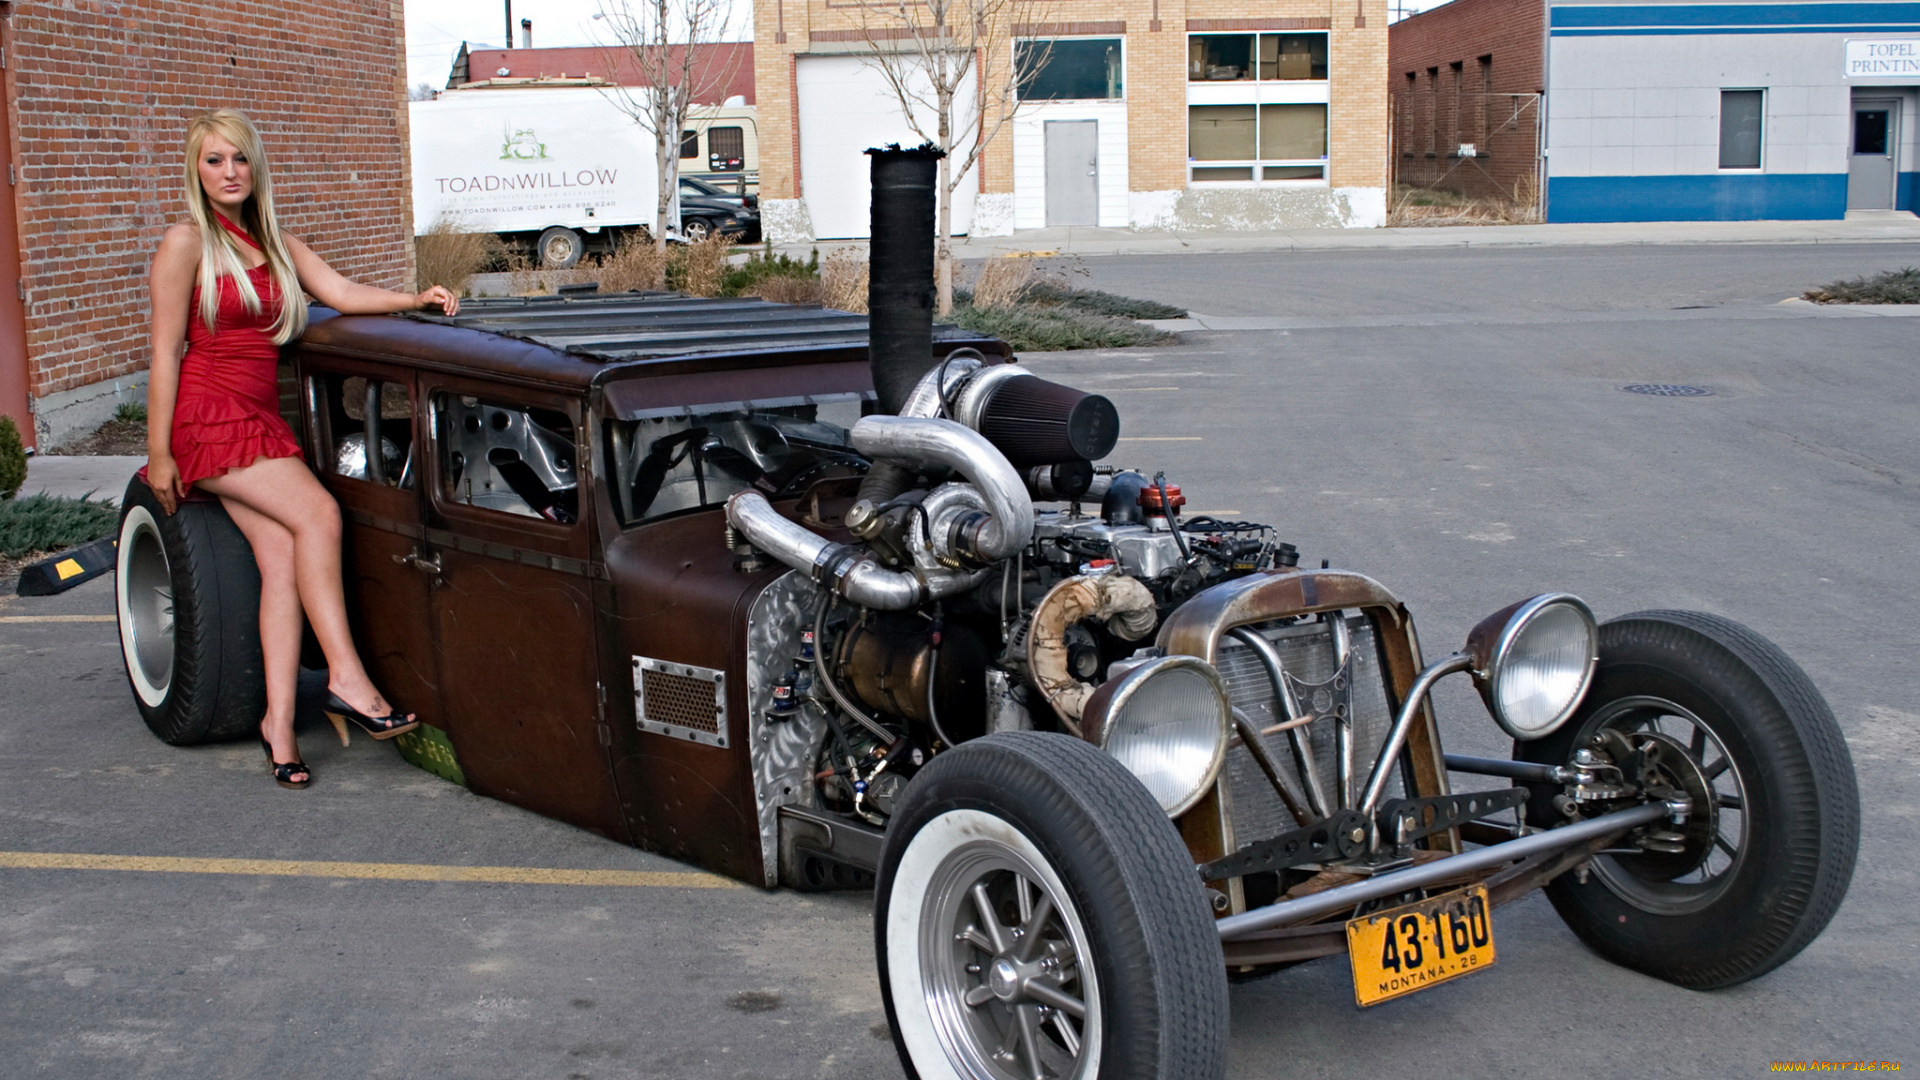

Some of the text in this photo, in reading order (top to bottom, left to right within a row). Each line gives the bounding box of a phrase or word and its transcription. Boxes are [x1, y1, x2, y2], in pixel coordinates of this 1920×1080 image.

[1866, 44, 1916, 56] TOPEL
[1851, 60, 1920, 72] PRINTIN
[1379, 954, 1477, 994] MONTANA 28
